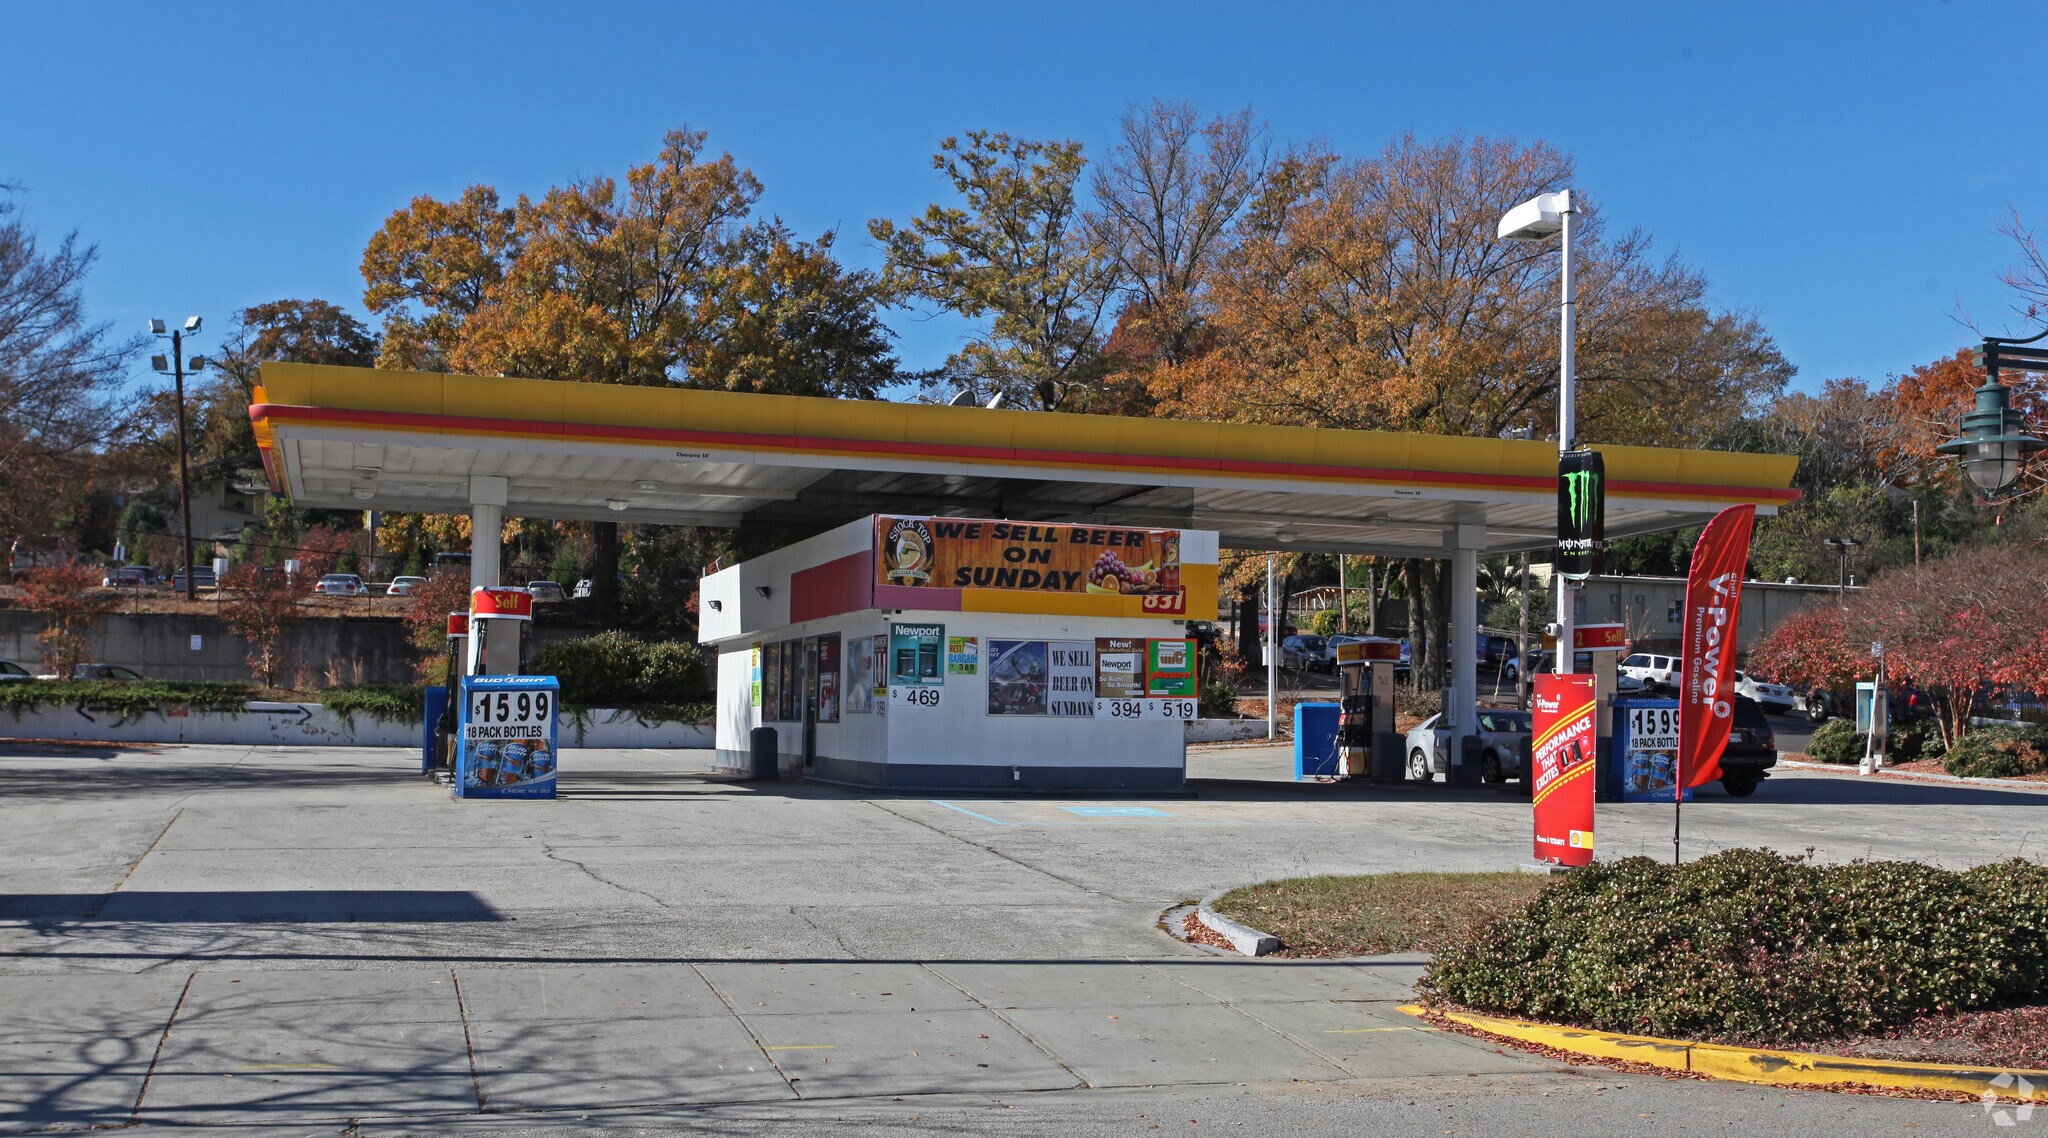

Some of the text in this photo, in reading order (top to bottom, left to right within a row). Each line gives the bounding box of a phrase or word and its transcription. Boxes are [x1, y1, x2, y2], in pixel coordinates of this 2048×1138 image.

[934, 522, 982, 540] WE
[991, 523, 1059, 543] SELL
[1069, 527, 1146, 548] BEER
[1002, 546, 1052, 564] ON
[952, 566, 1082, 590] SUNDAY
[495, 594, 519, 609] Self
[895, 625, 940, 637] Newport
[1576, 629, 1622, 646] 2 Self
[949, 645, 961, 653] BEST
[1109, 640, 1132, 648] New!
[1702, 571, 1731, 711] V-Power
[949, 654, 978, 664] BARGAIN
[1052, 650, 1091, 667] WE SELL
[1691, 606, 1705, 705] Premium Gasoline
[1101, 659, 1132, 670] Newport
[1052, 676, 1078, 692] BEER
[892, 689, 898, 698] $
[907, 690, 940, 706] 4.69
[1536, 698, 1560, 709] V-Power
[474, 692, 549, 722] $15.99
[1097, 701, 1142, 718] $ 3.94
[1148, 702, 1193, 718] $ 5.19
[467, 725, 542, 738] 18 PACK BOTTLES
[1535, 716, 1592, 764] PERFORMANCE
[507, 744, 528, 753] BUD
[1631, 737, 1679, 748] 18 PACK BOTTLE
[1541, 750, 1558, 773] THAT
[1536, 764, 1560, 792] EXCITES
